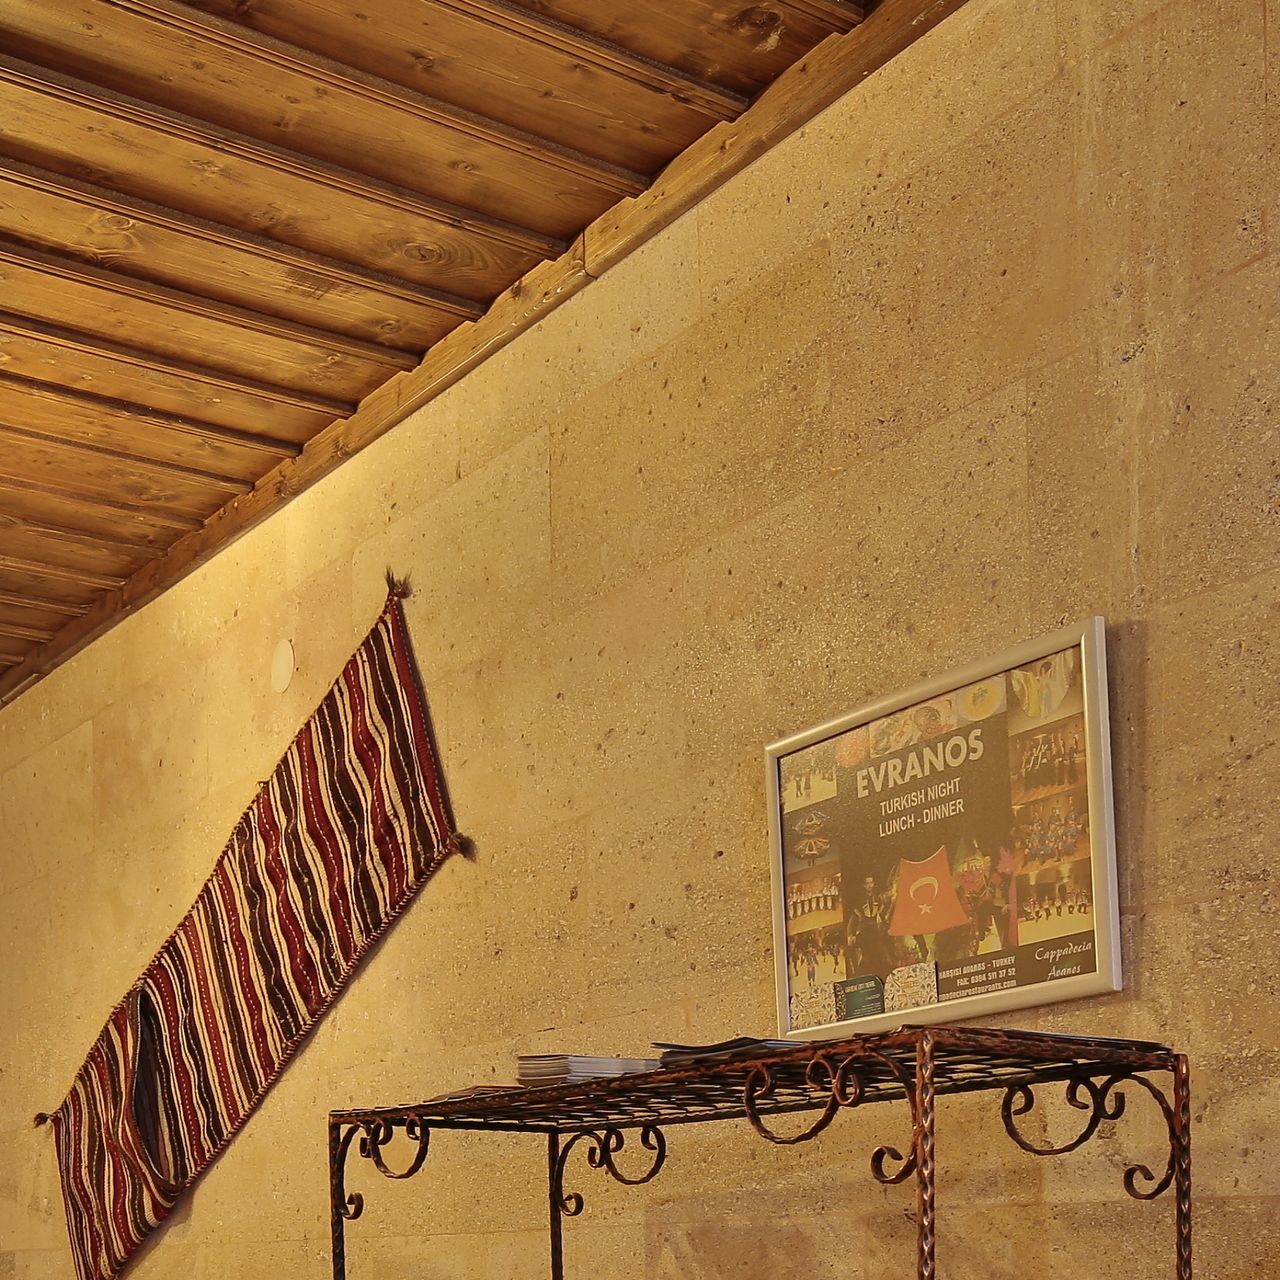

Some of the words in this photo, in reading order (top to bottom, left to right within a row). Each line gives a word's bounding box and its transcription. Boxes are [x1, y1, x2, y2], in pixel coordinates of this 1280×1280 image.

[856, 729, 984, 798] EVRANOS
[880, 790, 925, 816] TURKISH
[928, 778, 960, 801] NIGHT
[880, 814, 914, 837] LUNCH
[924, 799, 964, 823] DINNER
[993, 956, 1015, 968] TURKEY
[1035, 942, 1092, 962] Cappadocia
